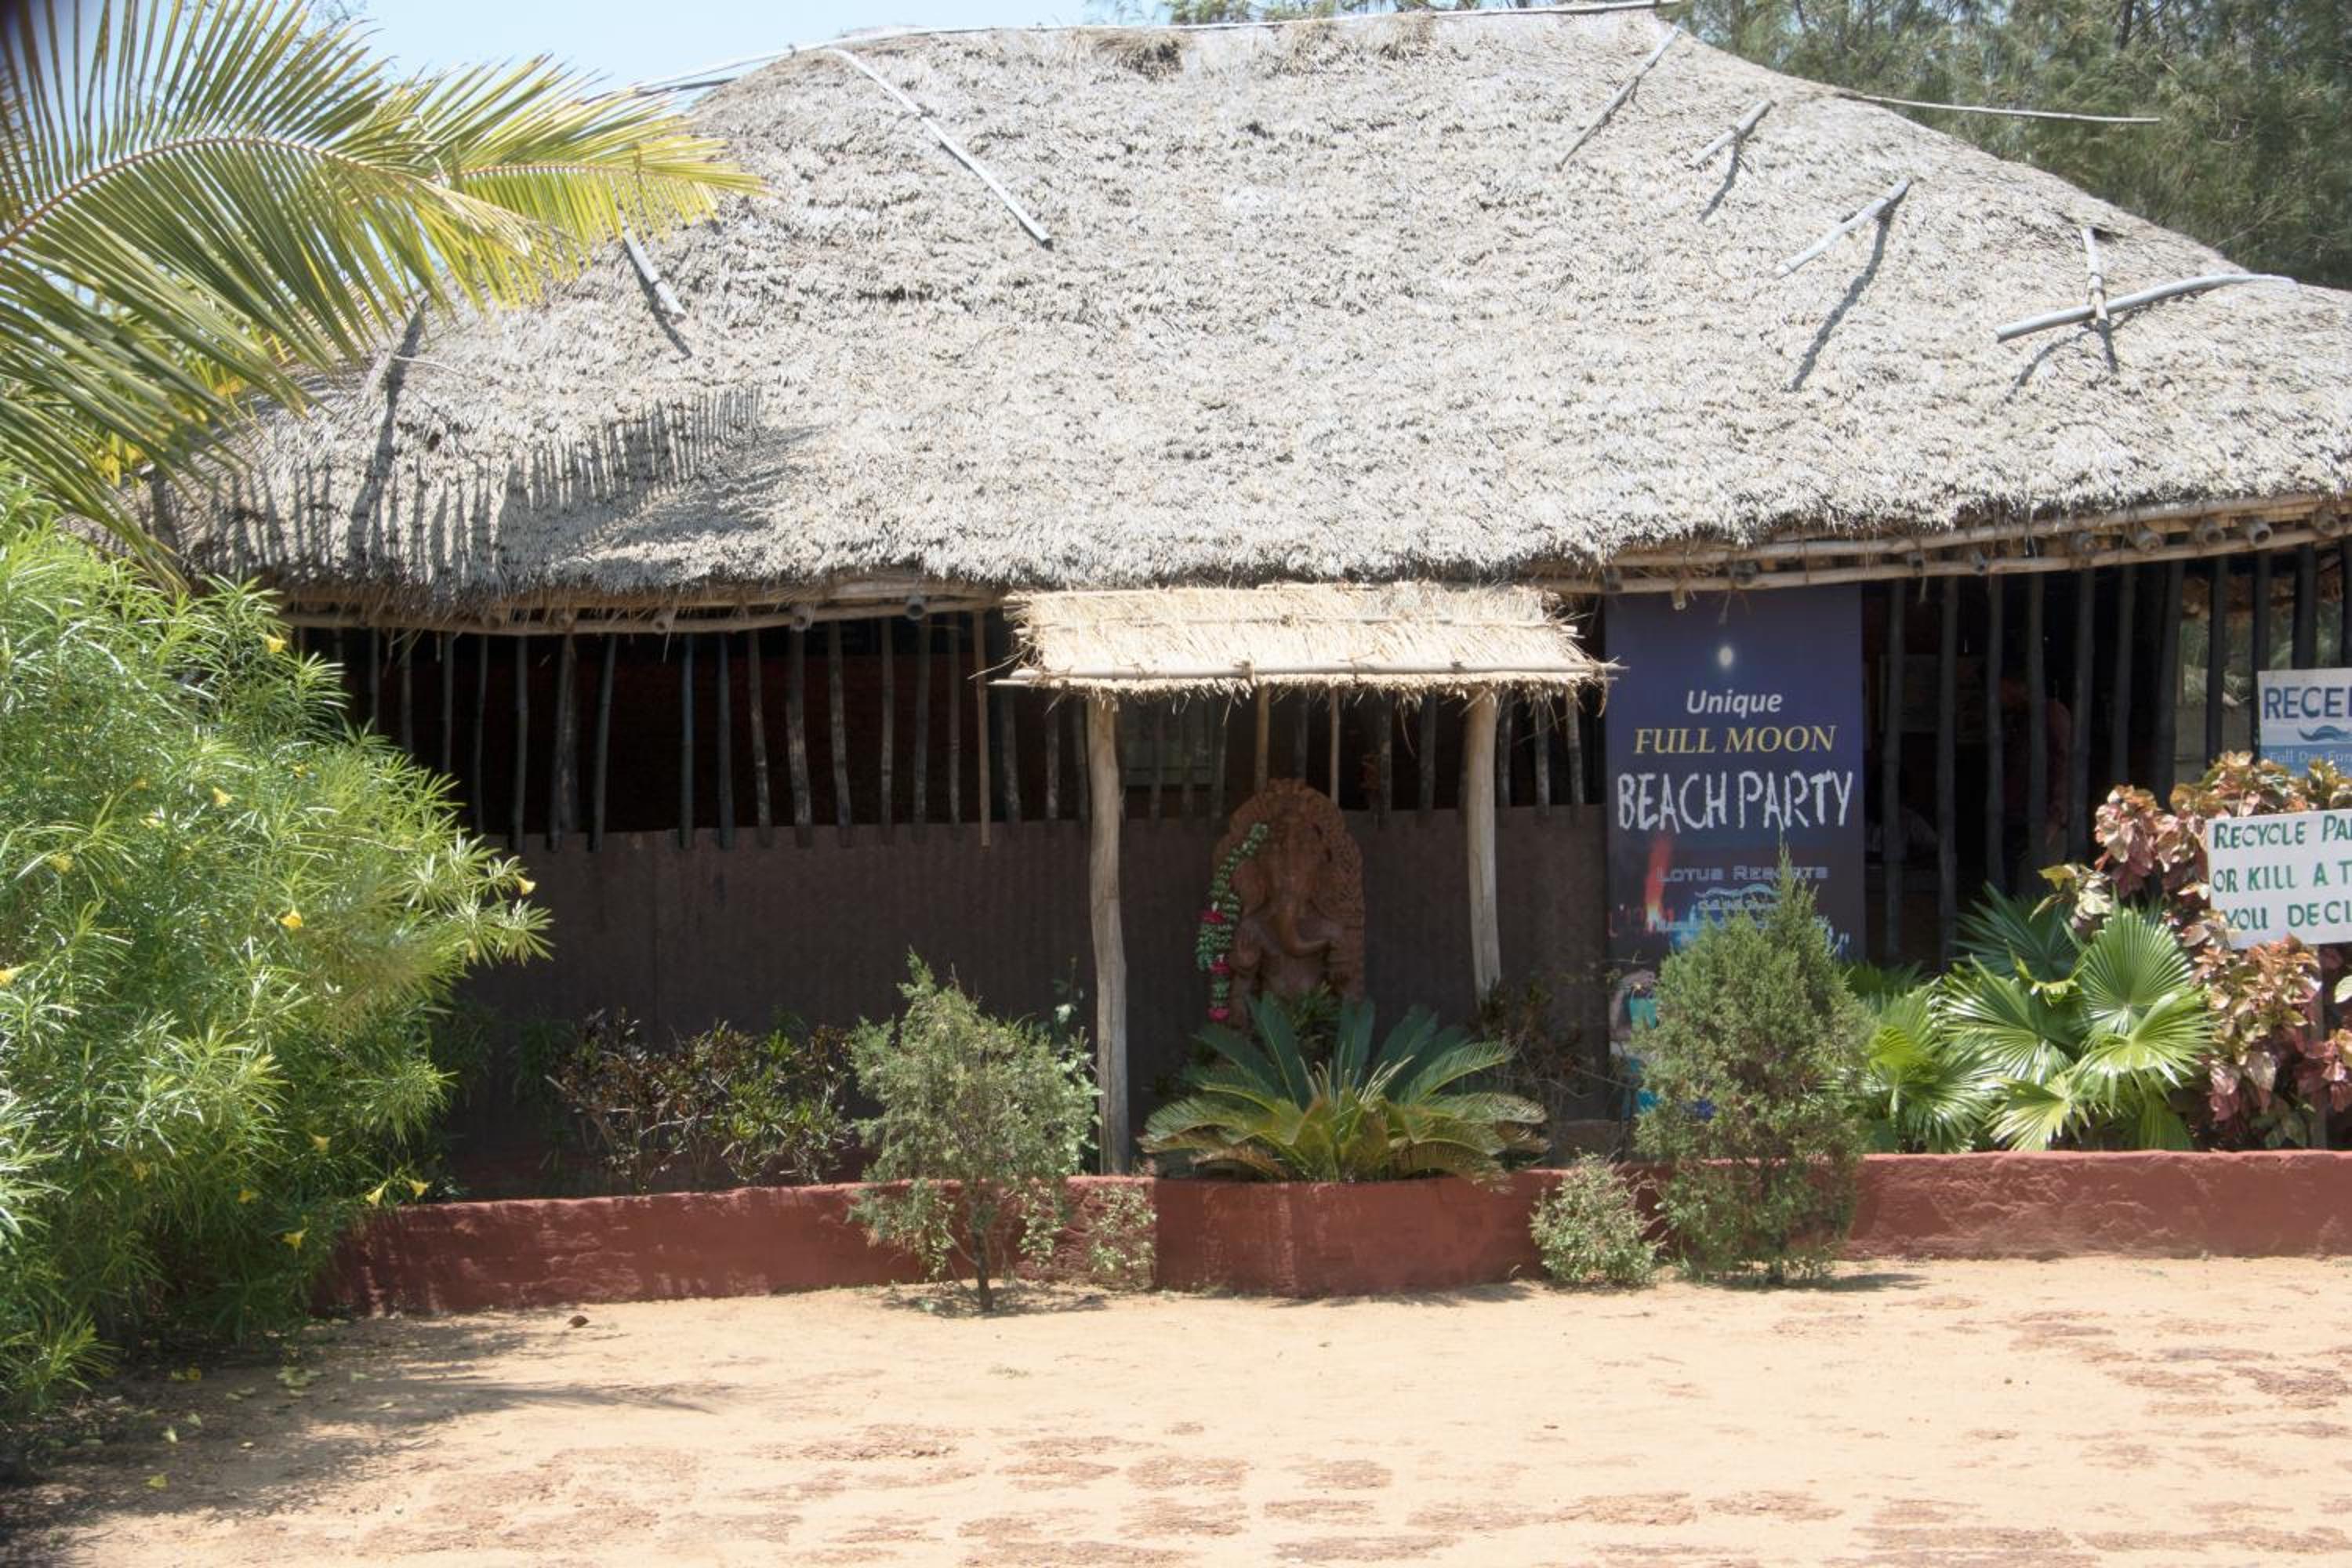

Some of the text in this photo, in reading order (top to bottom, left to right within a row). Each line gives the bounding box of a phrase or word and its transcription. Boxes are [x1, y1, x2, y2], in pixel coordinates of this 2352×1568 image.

[1687, 688, 1783, 719] Unique
[2263, 685, 2352, 720] RECE
[1635, 725, 1837, 753] FULL MOON
[1618, 770, 1853, 833] BEACH PARTY
[2214, 822, 2307, 849] RECYCLE
[2213, 869, 2238, 893] OR
[2248, 865, 2297, 891] KILL
[2314, 862, 2329, 887] A
[2225, 906, 2269, 930] YOU
